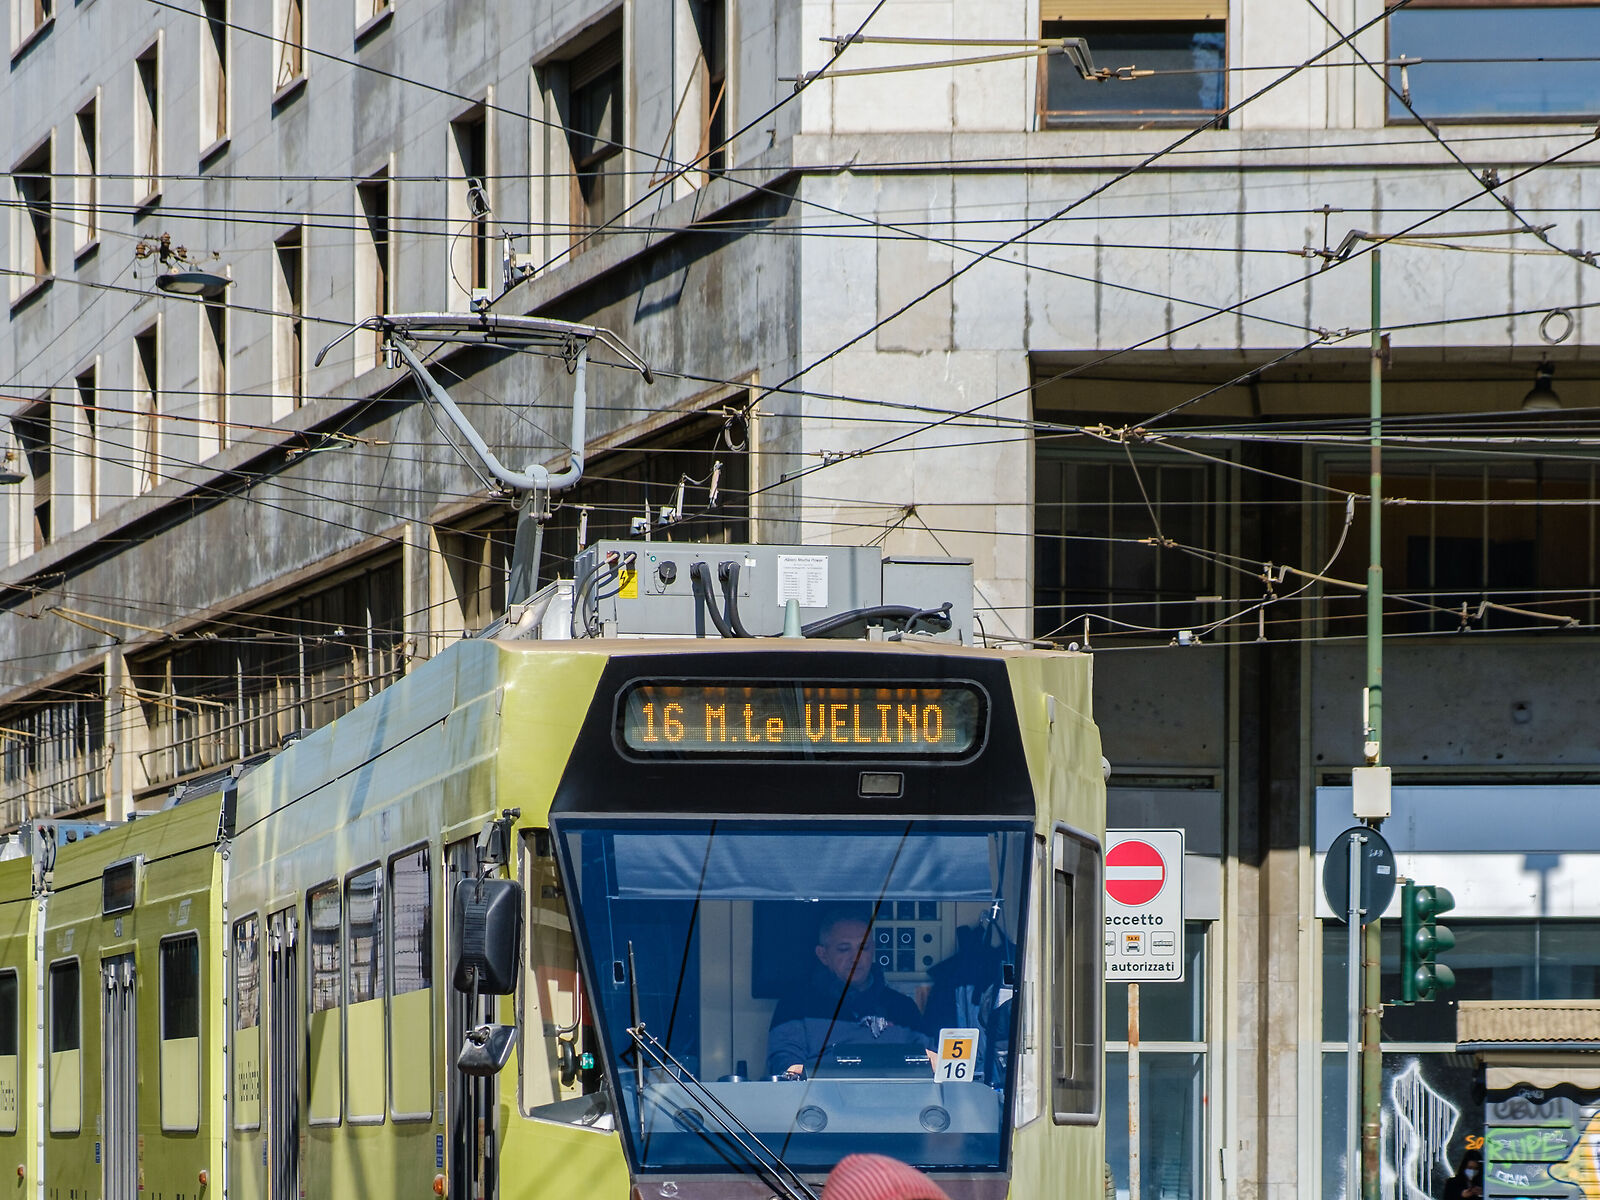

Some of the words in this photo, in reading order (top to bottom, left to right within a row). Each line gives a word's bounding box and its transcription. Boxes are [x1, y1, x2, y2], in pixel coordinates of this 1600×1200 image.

[643, 702, 685, 742] 16
[706, 703, 784, 743] M.te
[805, 703, 943, 743] VELINO
[1105, 914, 1164, 926] eccetto
[1111, 961, 1175, 972] autorizzati
[951, 1041, 964, 1059] 5
[943, 1062, 967, 1079] 16
